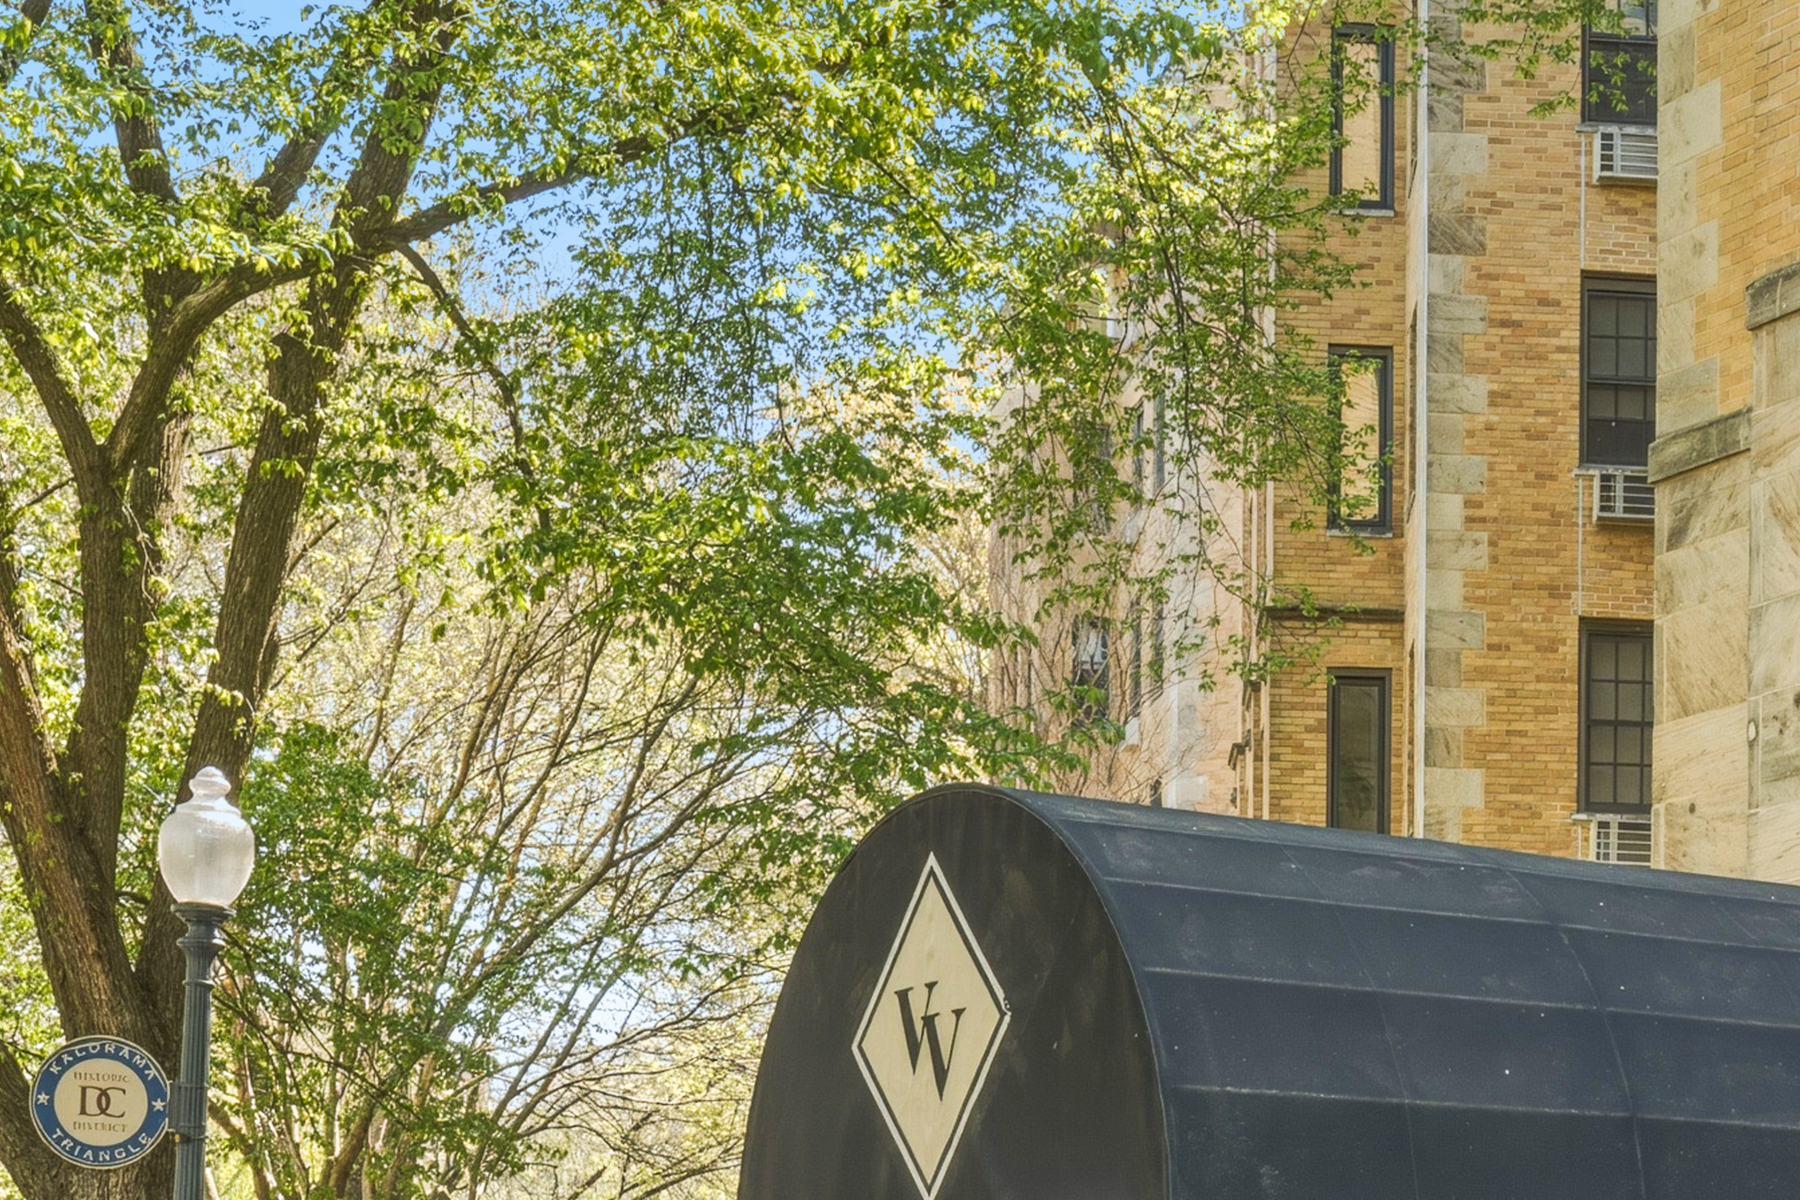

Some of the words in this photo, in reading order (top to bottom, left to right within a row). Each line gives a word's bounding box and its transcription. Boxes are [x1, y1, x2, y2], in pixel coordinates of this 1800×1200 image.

[48, 1040, 156, 1081] KALORAMA
[73, 1071, 130, 1083] HISTORIC
[78, 1085, 126, 1118] DC
[73, 1120, 129, 1133] DISTRICT
[51, 1127, 153, 1162] TRIANGLE
